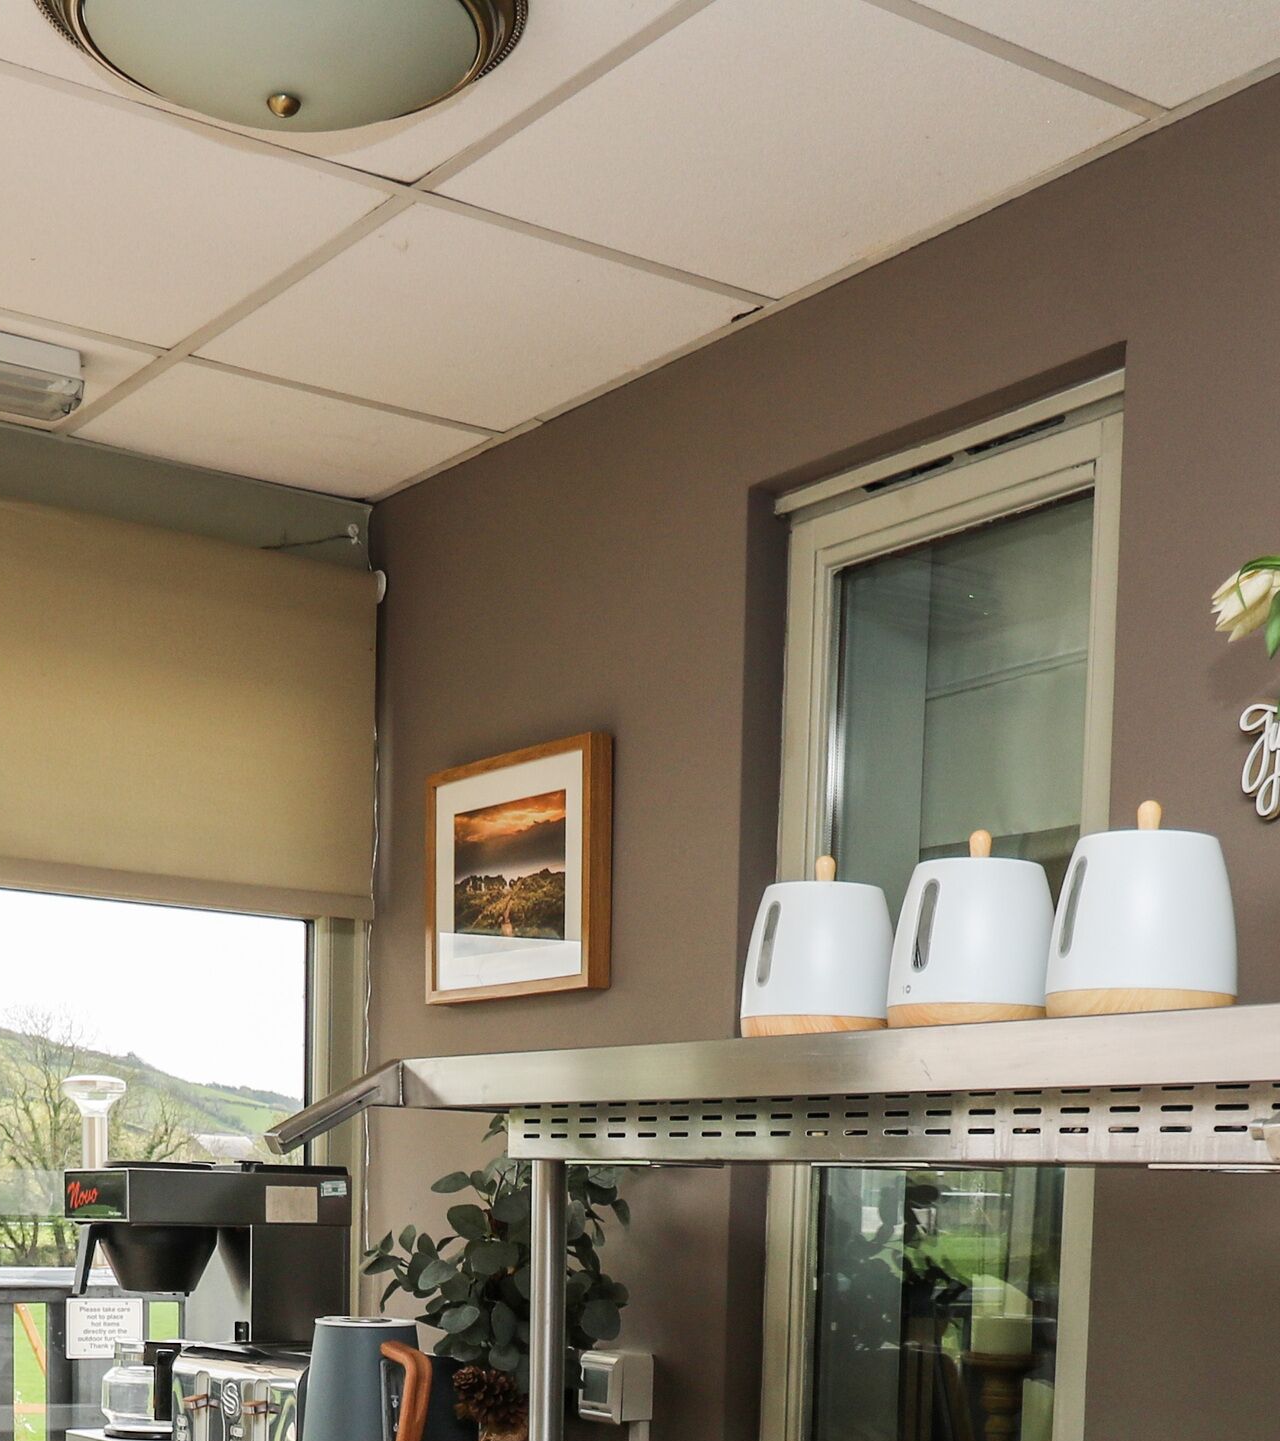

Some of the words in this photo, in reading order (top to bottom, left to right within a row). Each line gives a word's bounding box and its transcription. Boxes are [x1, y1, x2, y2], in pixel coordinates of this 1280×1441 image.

[67, 1180, 98, 1209] Novo
[83, 1328, 107, 1336] directly
[77, 1335, 103, 1343] outdoor
